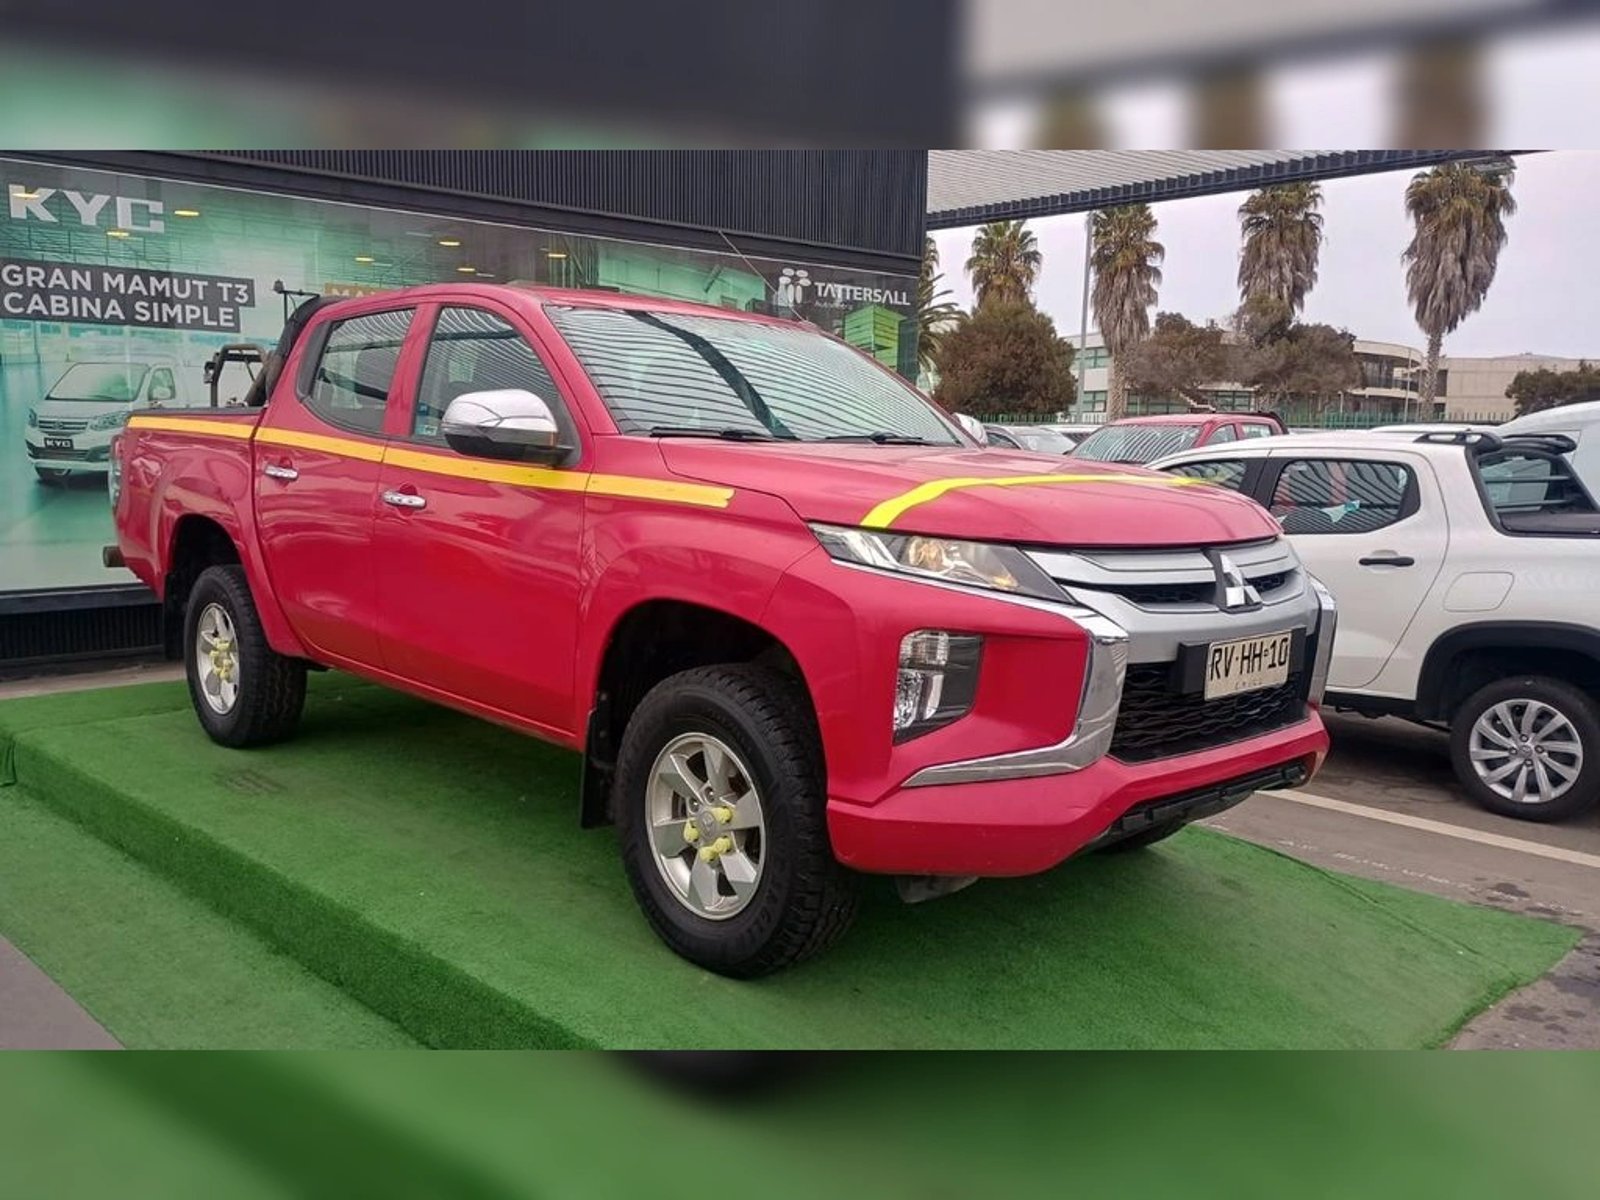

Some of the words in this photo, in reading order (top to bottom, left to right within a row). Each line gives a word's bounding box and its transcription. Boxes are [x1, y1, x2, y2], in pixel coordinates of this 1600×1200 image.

[8, 184, 165, 233] KYC
[1, 264, 92, 291] GRAN
[103, 272, 209, 300] MAMUT
[217, 282, 249, 304] T3
[814, 282, 911, 305] TATTERSALL
[4, 292, 126, 320] CABINA
[134, 303, 236, 328] SIMPLE
